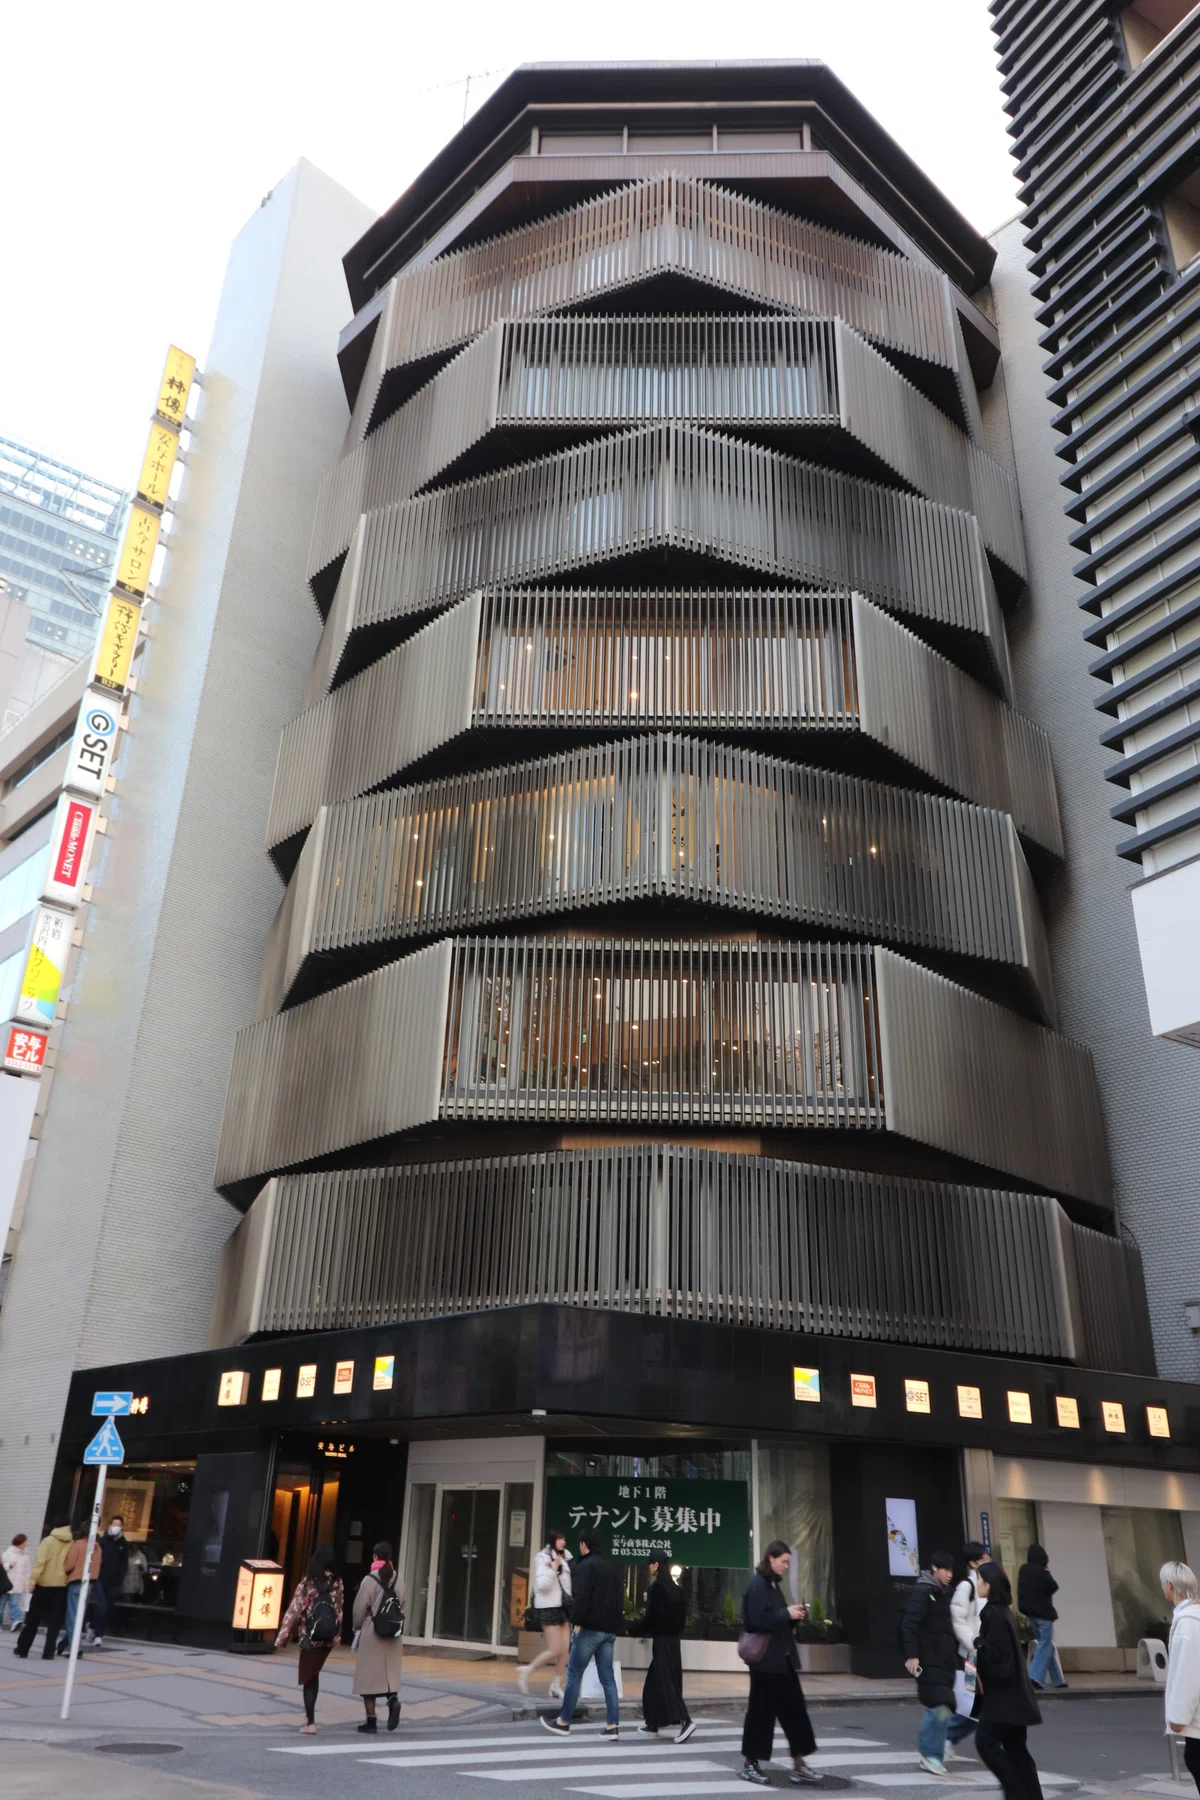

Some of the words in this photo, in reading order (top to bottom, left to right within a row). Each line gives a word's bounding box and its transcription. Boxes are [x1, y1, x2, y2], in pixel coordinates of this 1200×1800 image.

[101, 677, 119, 690] B2F
[61, 841, 78, 879] MONET
[14, 1033, 42, 1051] 安与
[12, 1045, 39, 1062] ビル
[618, 1485, 667, 1500] 地下1階
[568, 1505, 722, 1535] テナント募集中
[612, 1538, 672, 1549] 安与商事株式会社
